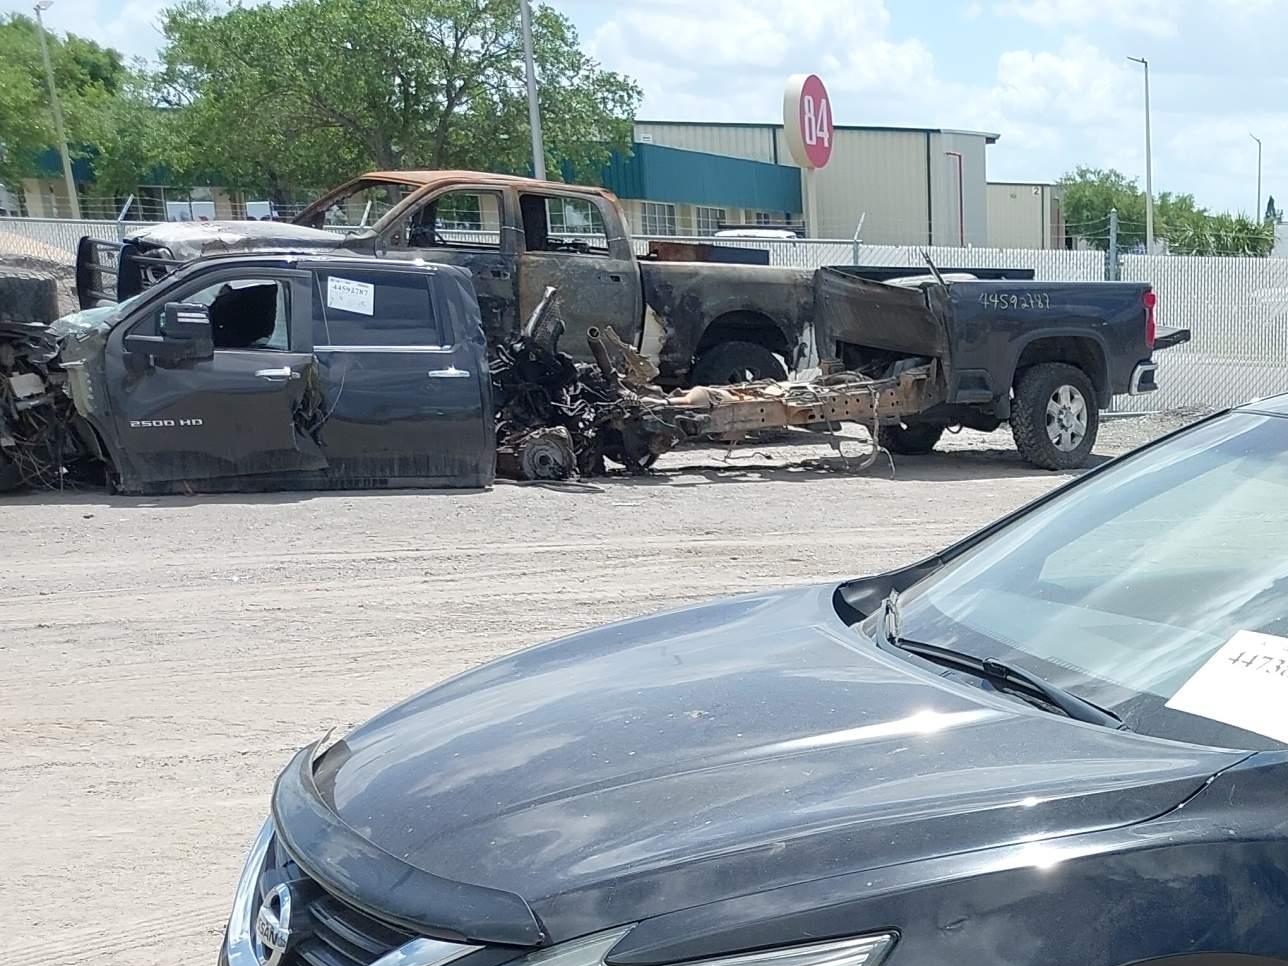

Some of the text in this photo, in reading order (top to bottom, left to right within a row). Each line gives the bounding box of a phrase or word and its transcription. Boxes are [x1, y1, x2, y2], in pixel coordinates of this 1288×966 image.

[804, 95, 829, 147] 84
[1033, 187, 1040, 196] 2
[979, 292, 1050, 310] 44592787
[179, 418, 203, 426] HD
